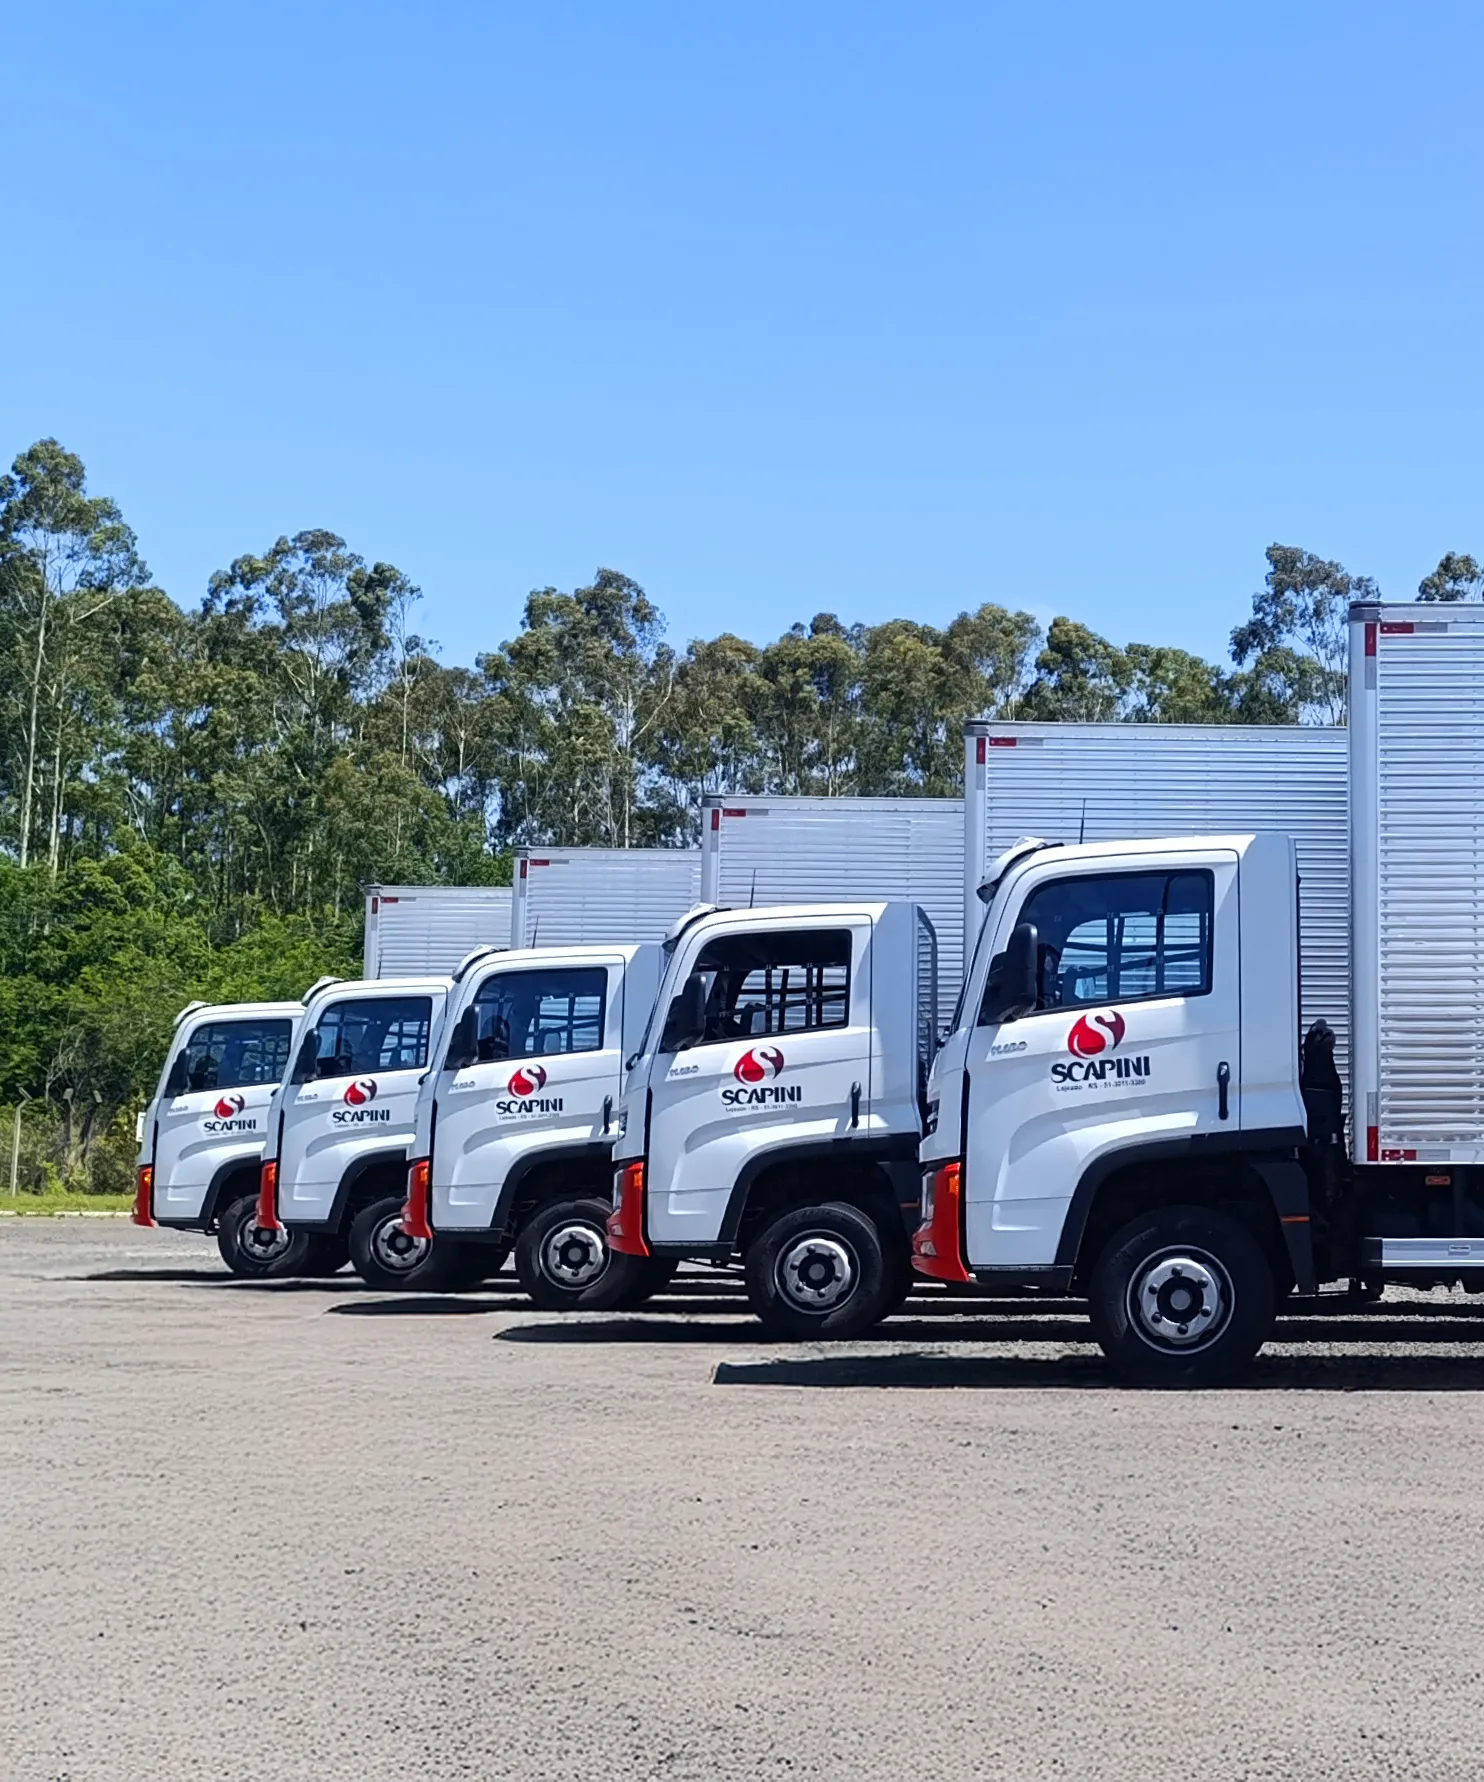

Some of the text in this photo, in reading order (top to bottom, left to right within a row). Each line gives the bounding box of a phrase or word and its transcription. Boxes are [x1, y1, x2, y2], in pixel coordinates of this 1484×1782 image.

[1050, 1056, 1151, 1084] SCAPINI
[721, 1085, 802, 1106] SCAPINI
[495, 1098, 563, 1115] SCAPINI
[332, 1109, 390, 1123] SCAPINI
[203, 1119, 257, 1132] SCAPINI
